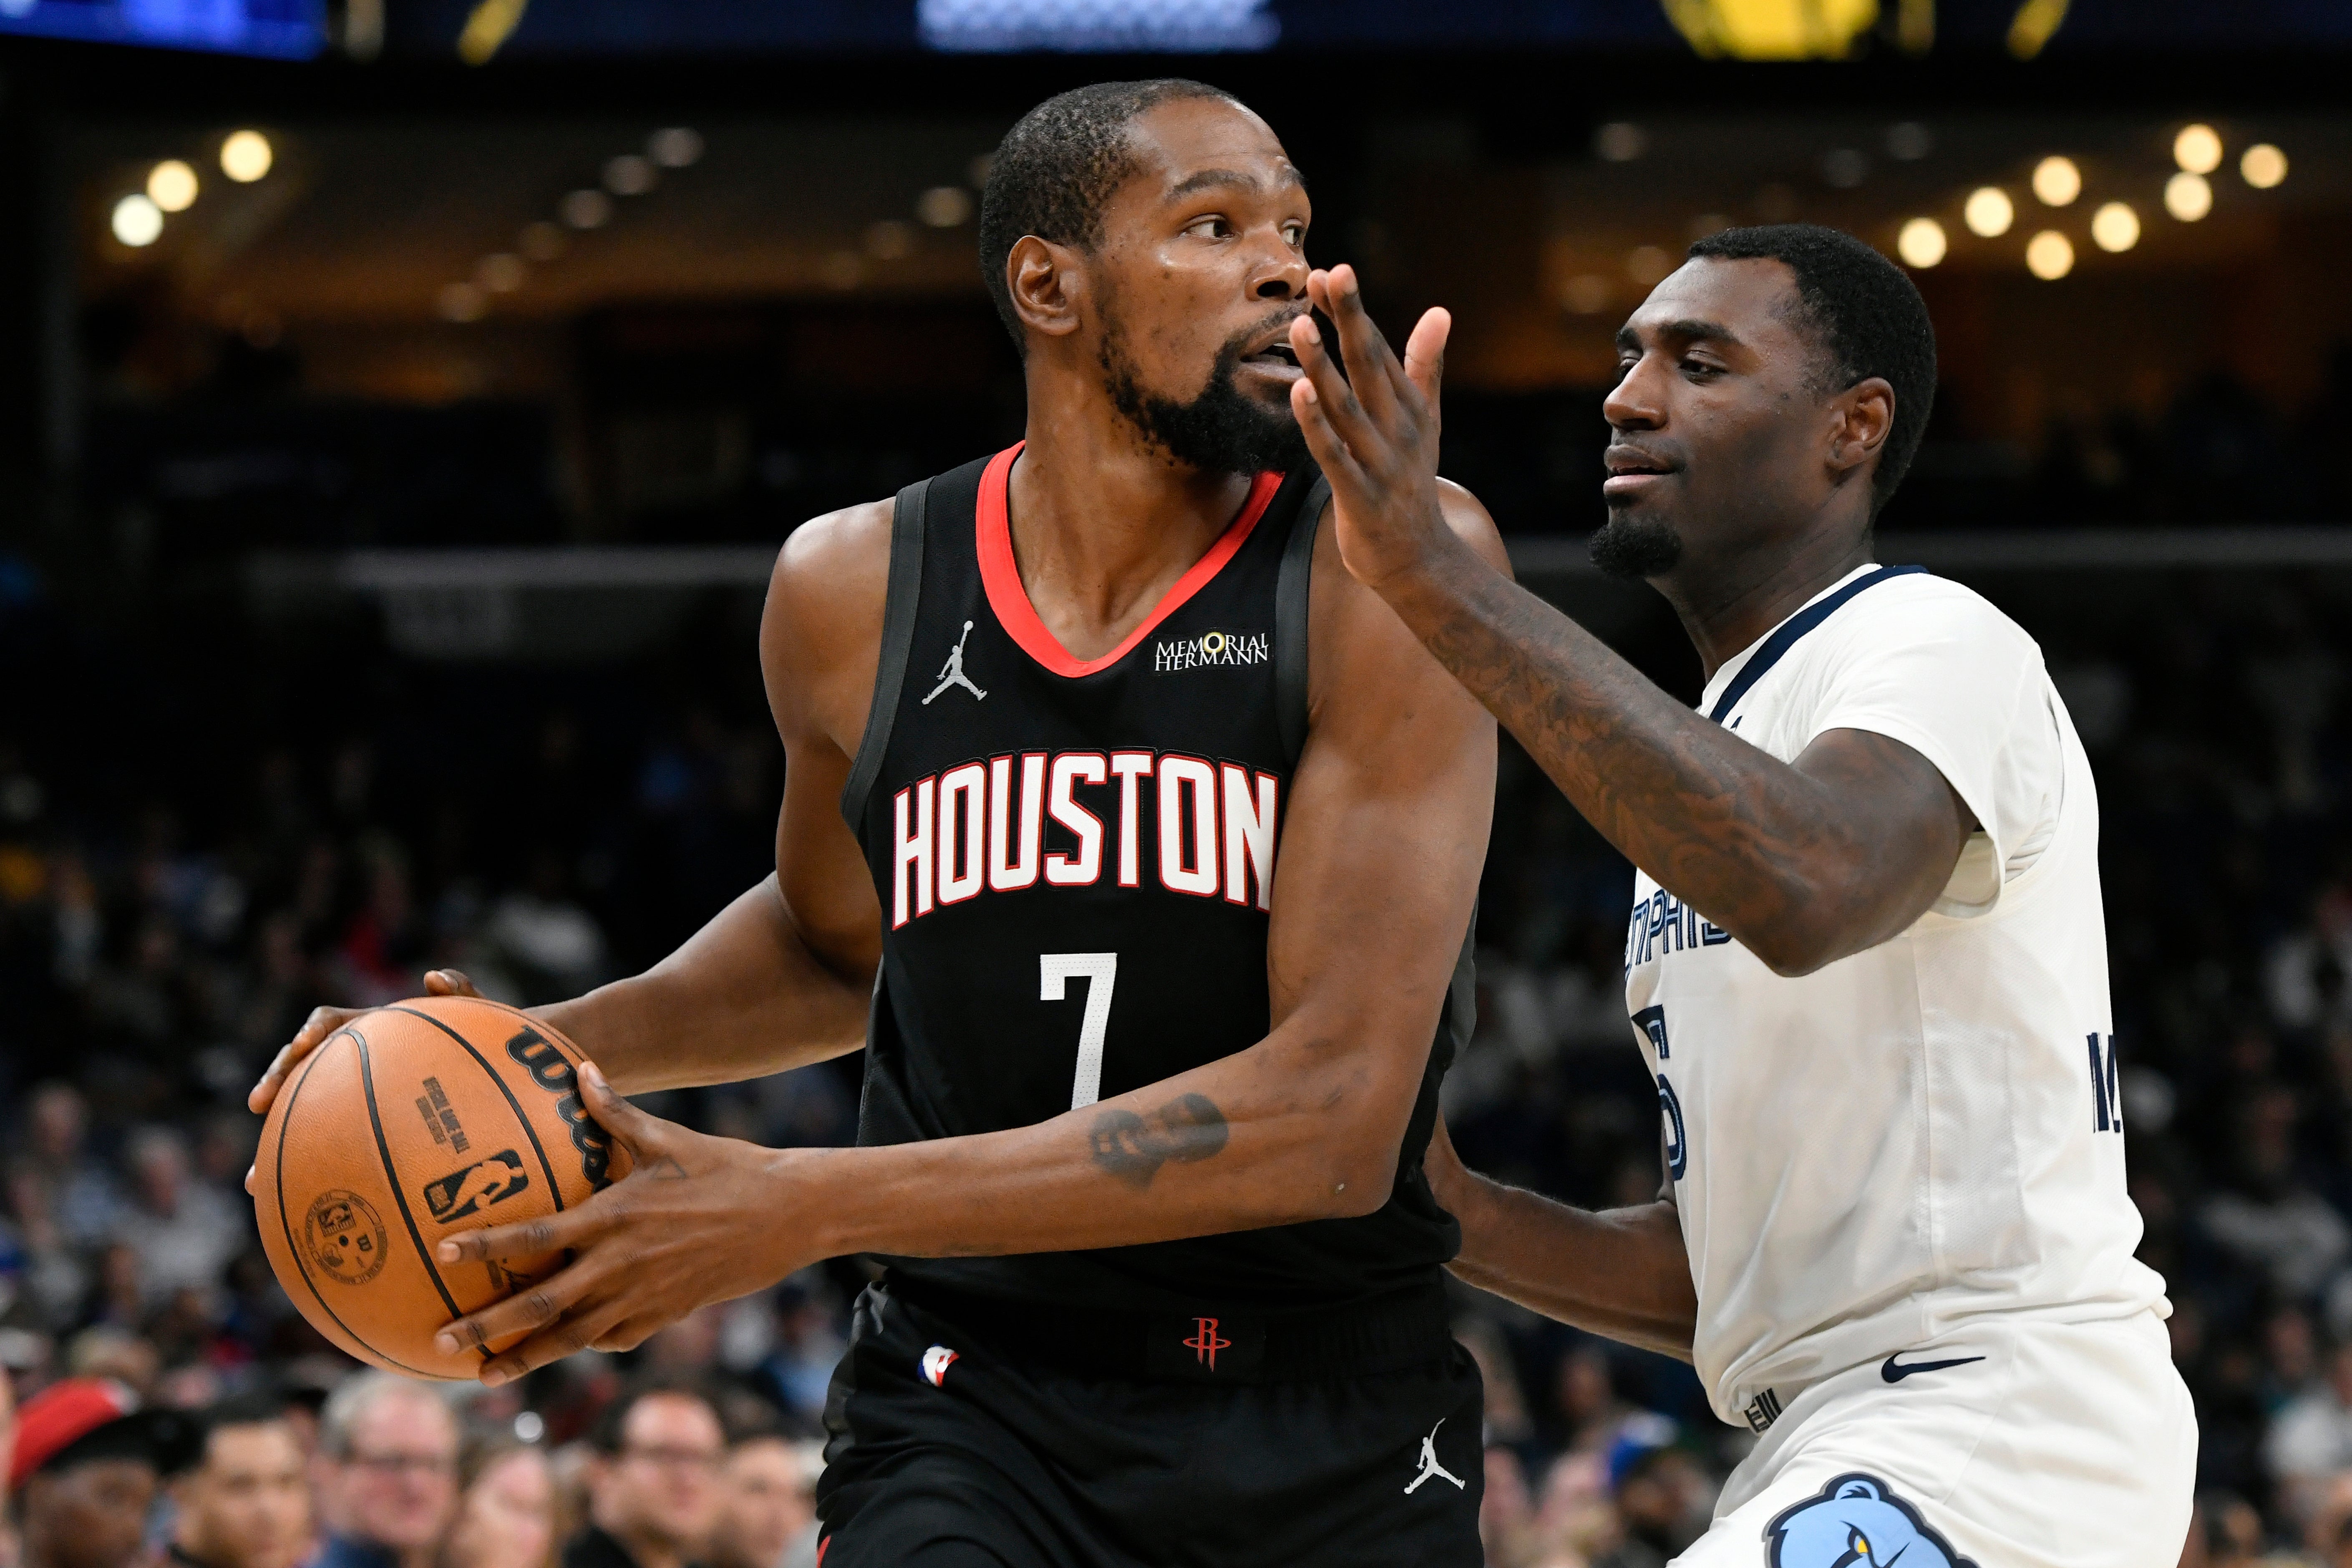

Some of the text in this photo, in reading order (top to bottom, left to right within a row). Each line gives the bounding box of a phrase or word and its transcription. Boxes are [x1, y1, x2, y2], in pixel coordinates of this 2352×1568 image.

[1154, 647, 1268, 671] HERMANN
[1155, 632, 1269, 657] MEMORIAL
[892, 750, 1279, 931] HOUSTON
[1040, 952, 1118, 1111] 7
